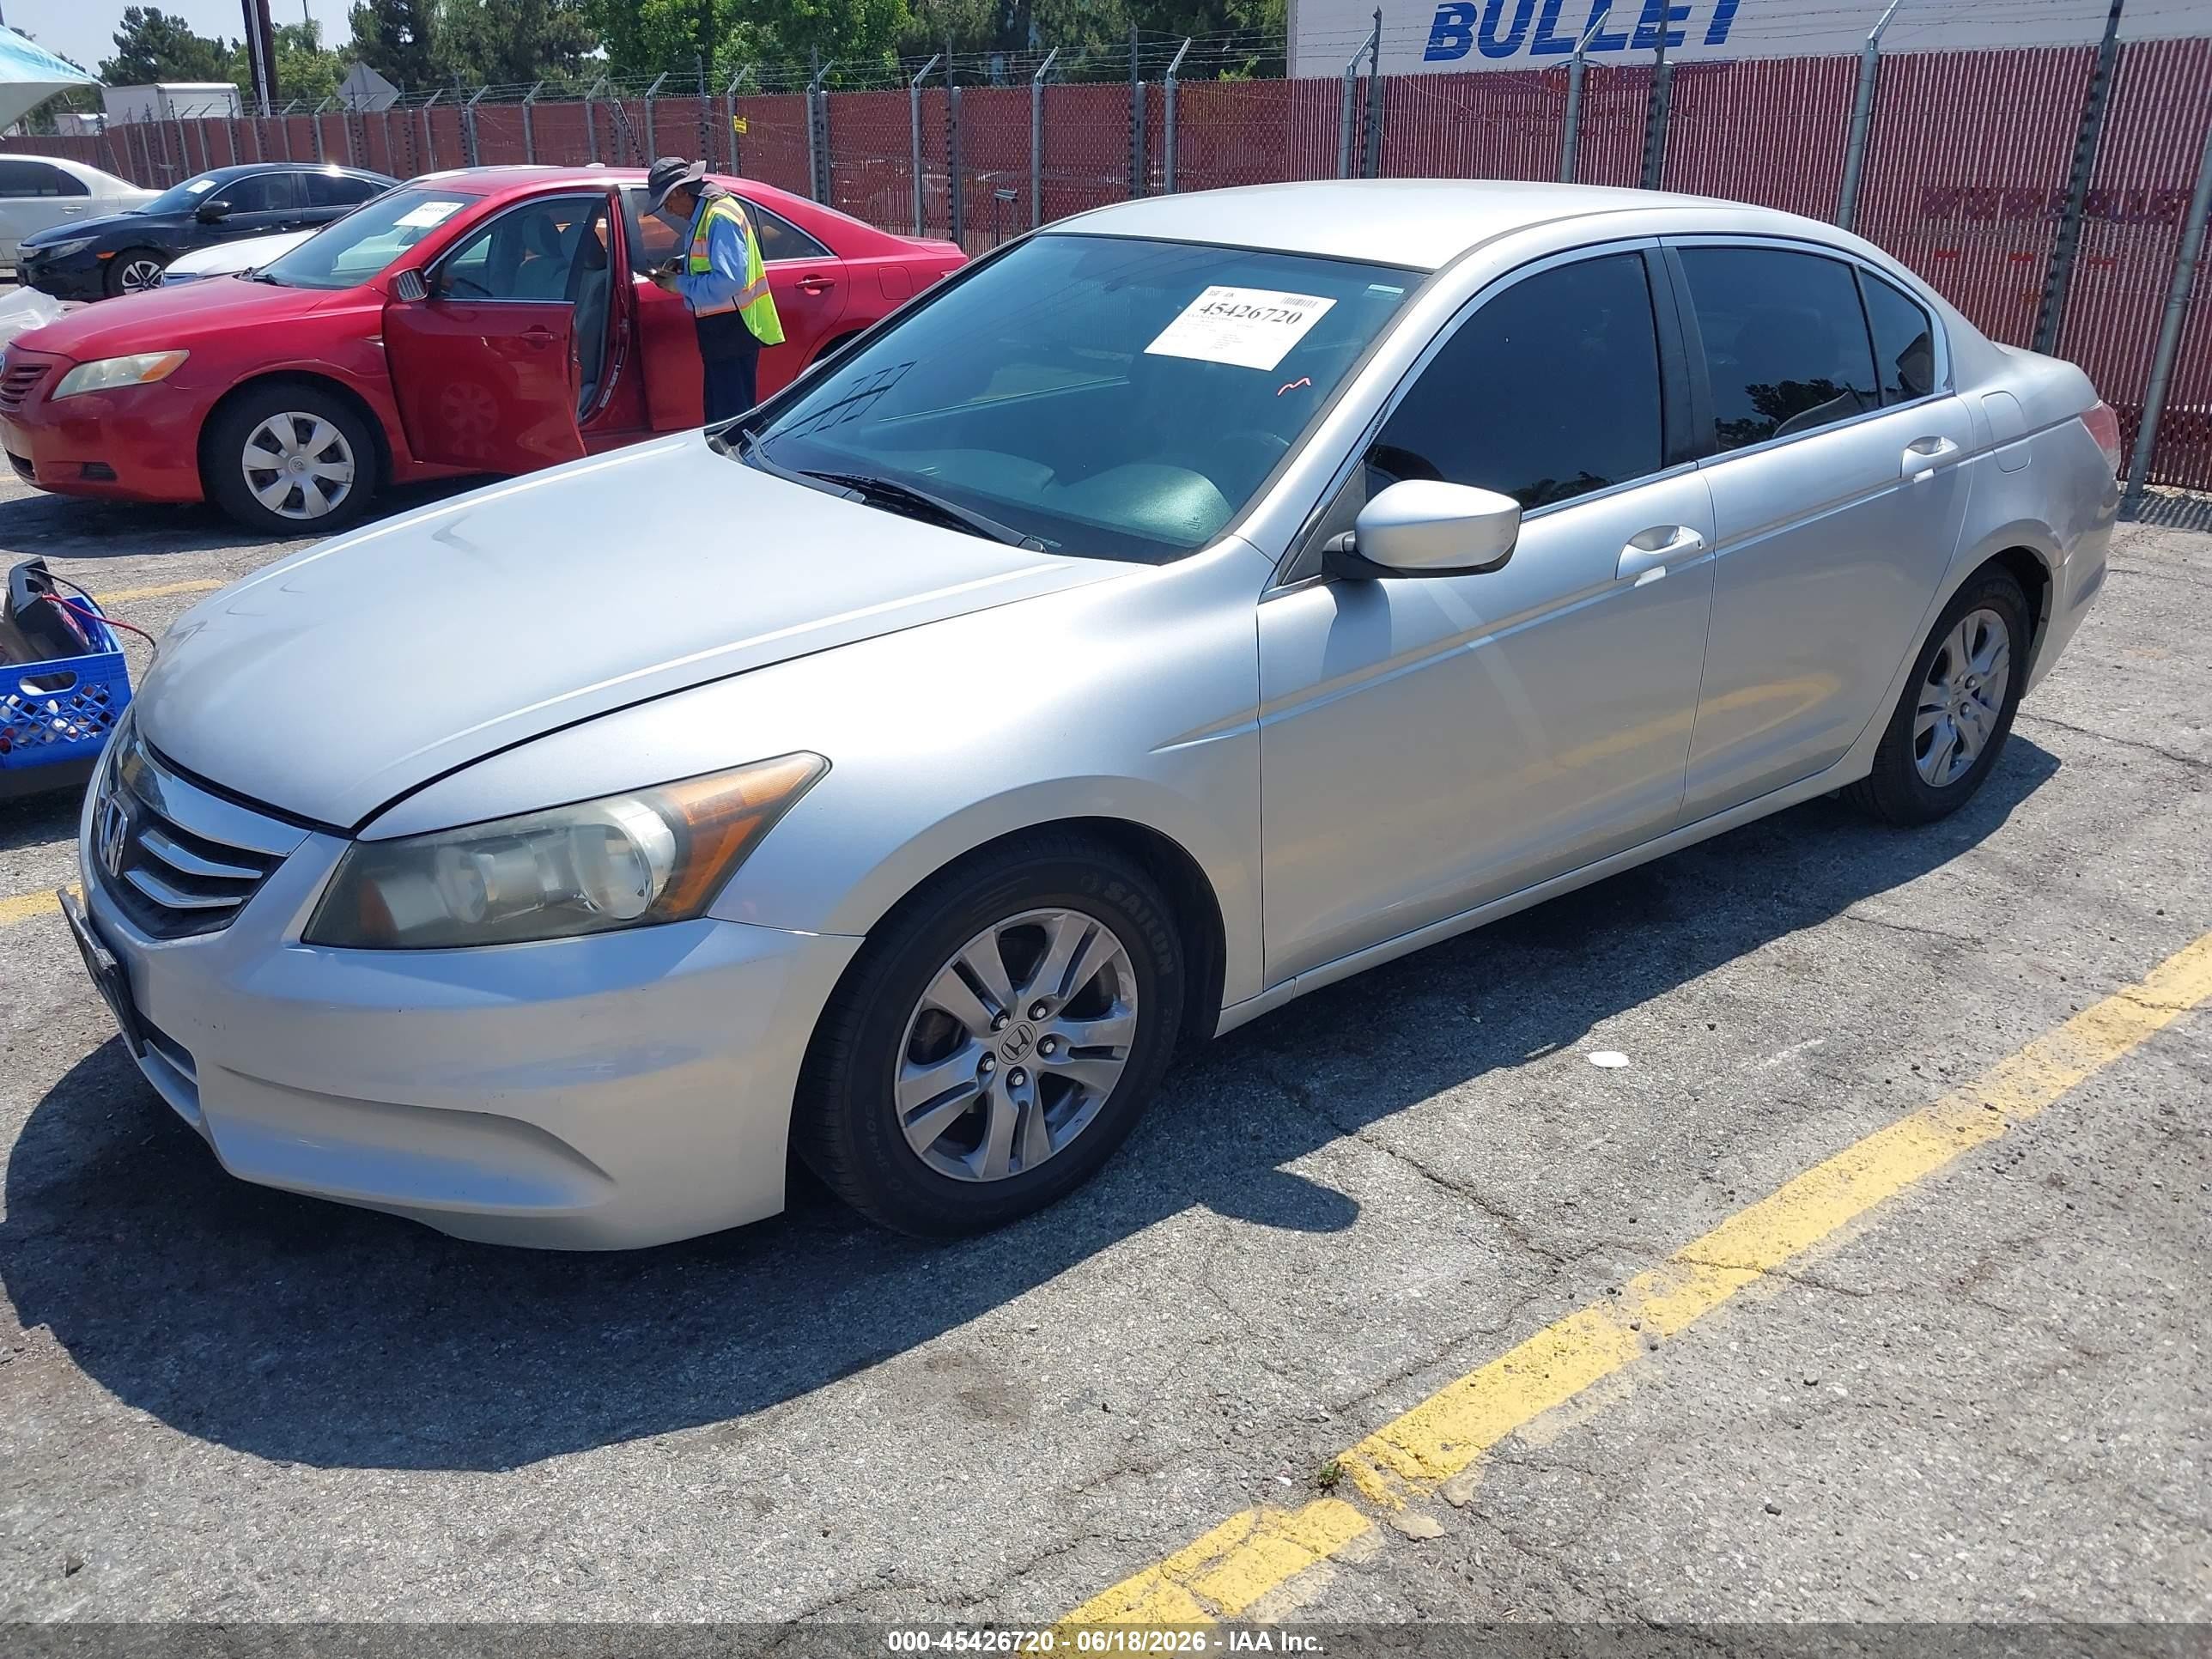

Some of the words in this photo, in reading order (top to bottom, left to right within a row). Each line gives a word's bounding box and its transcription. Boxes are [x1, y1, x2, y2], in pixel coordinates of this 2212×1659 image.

[1424, 0, 1739, 61] BULLET
[1200, 301, 1304, 325] 45426720
[1104, 881, 1175, 976] SAILUN
